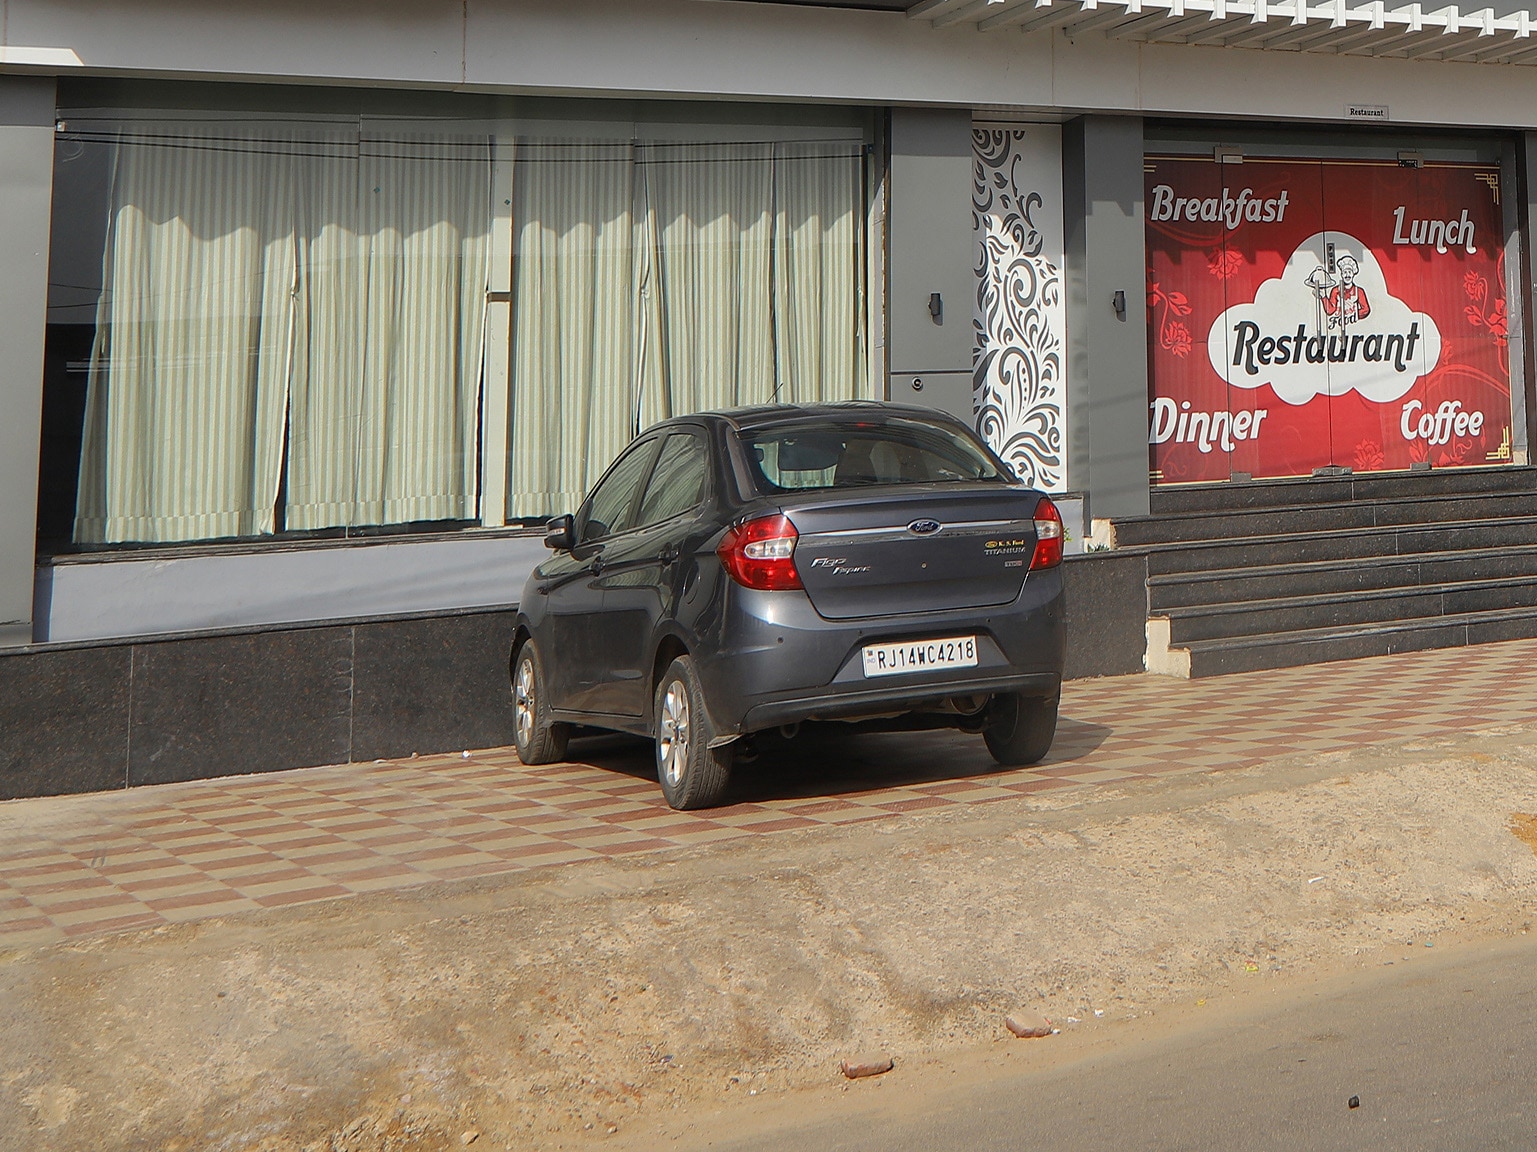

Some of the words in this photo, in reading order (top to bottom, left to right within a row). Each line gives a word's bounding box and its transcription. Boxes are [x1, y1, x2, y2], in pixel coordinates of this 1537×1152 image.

[1350, 108, 1384, 117] Restaurant
[1151, 184, 1290, 230] Breakfast
[1392, 206, 1477, 253] Lunch
[1232, 320, 1420, 375] Restaurant
[1148, 397, 1267, 453] Dinner
[1401, 399, 1484, 445] Coffee
[984, 546, 1026, 555] TITANIUM
[877, 640, 974, 669] RJ14WC4218
